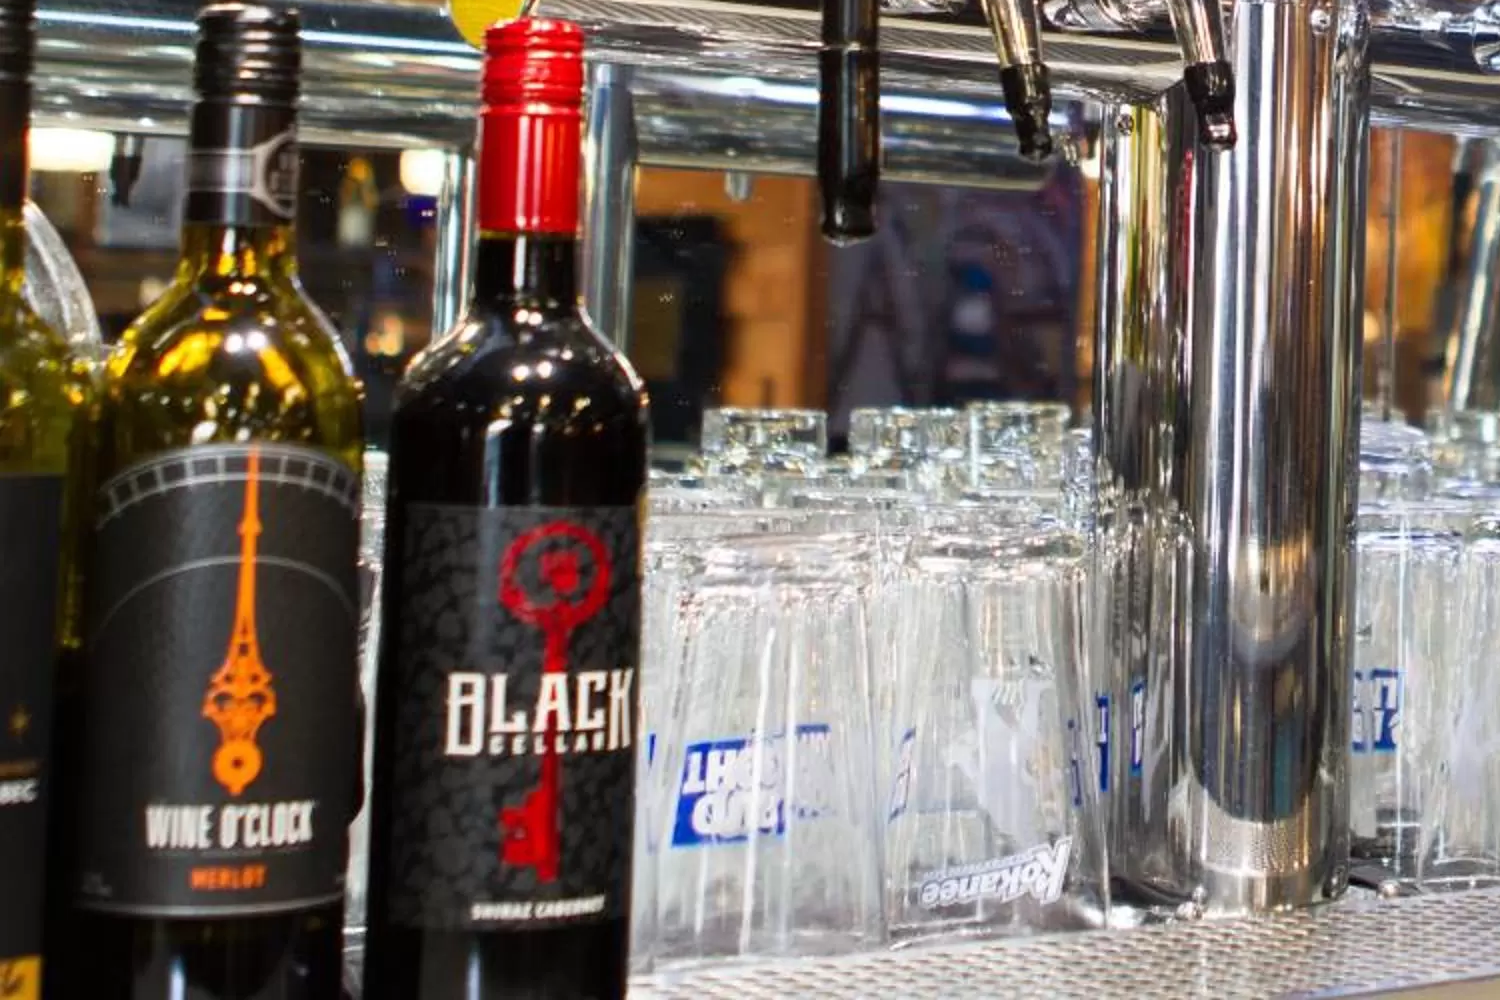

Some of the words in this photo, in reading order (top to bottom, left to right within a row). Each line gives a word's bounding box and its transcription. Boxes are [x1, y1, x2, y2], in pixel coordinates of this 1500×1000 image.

[444, 668, 634, 756] BLACK
[488, 730, 605, 755] CELLAR
[146, 804, 214, 849] WINE
[220, 800, 316, 849] O'CLOCK
[190, 864, 267, 889] MERLOT
[920, 837, 1072, 909] Kokanee
